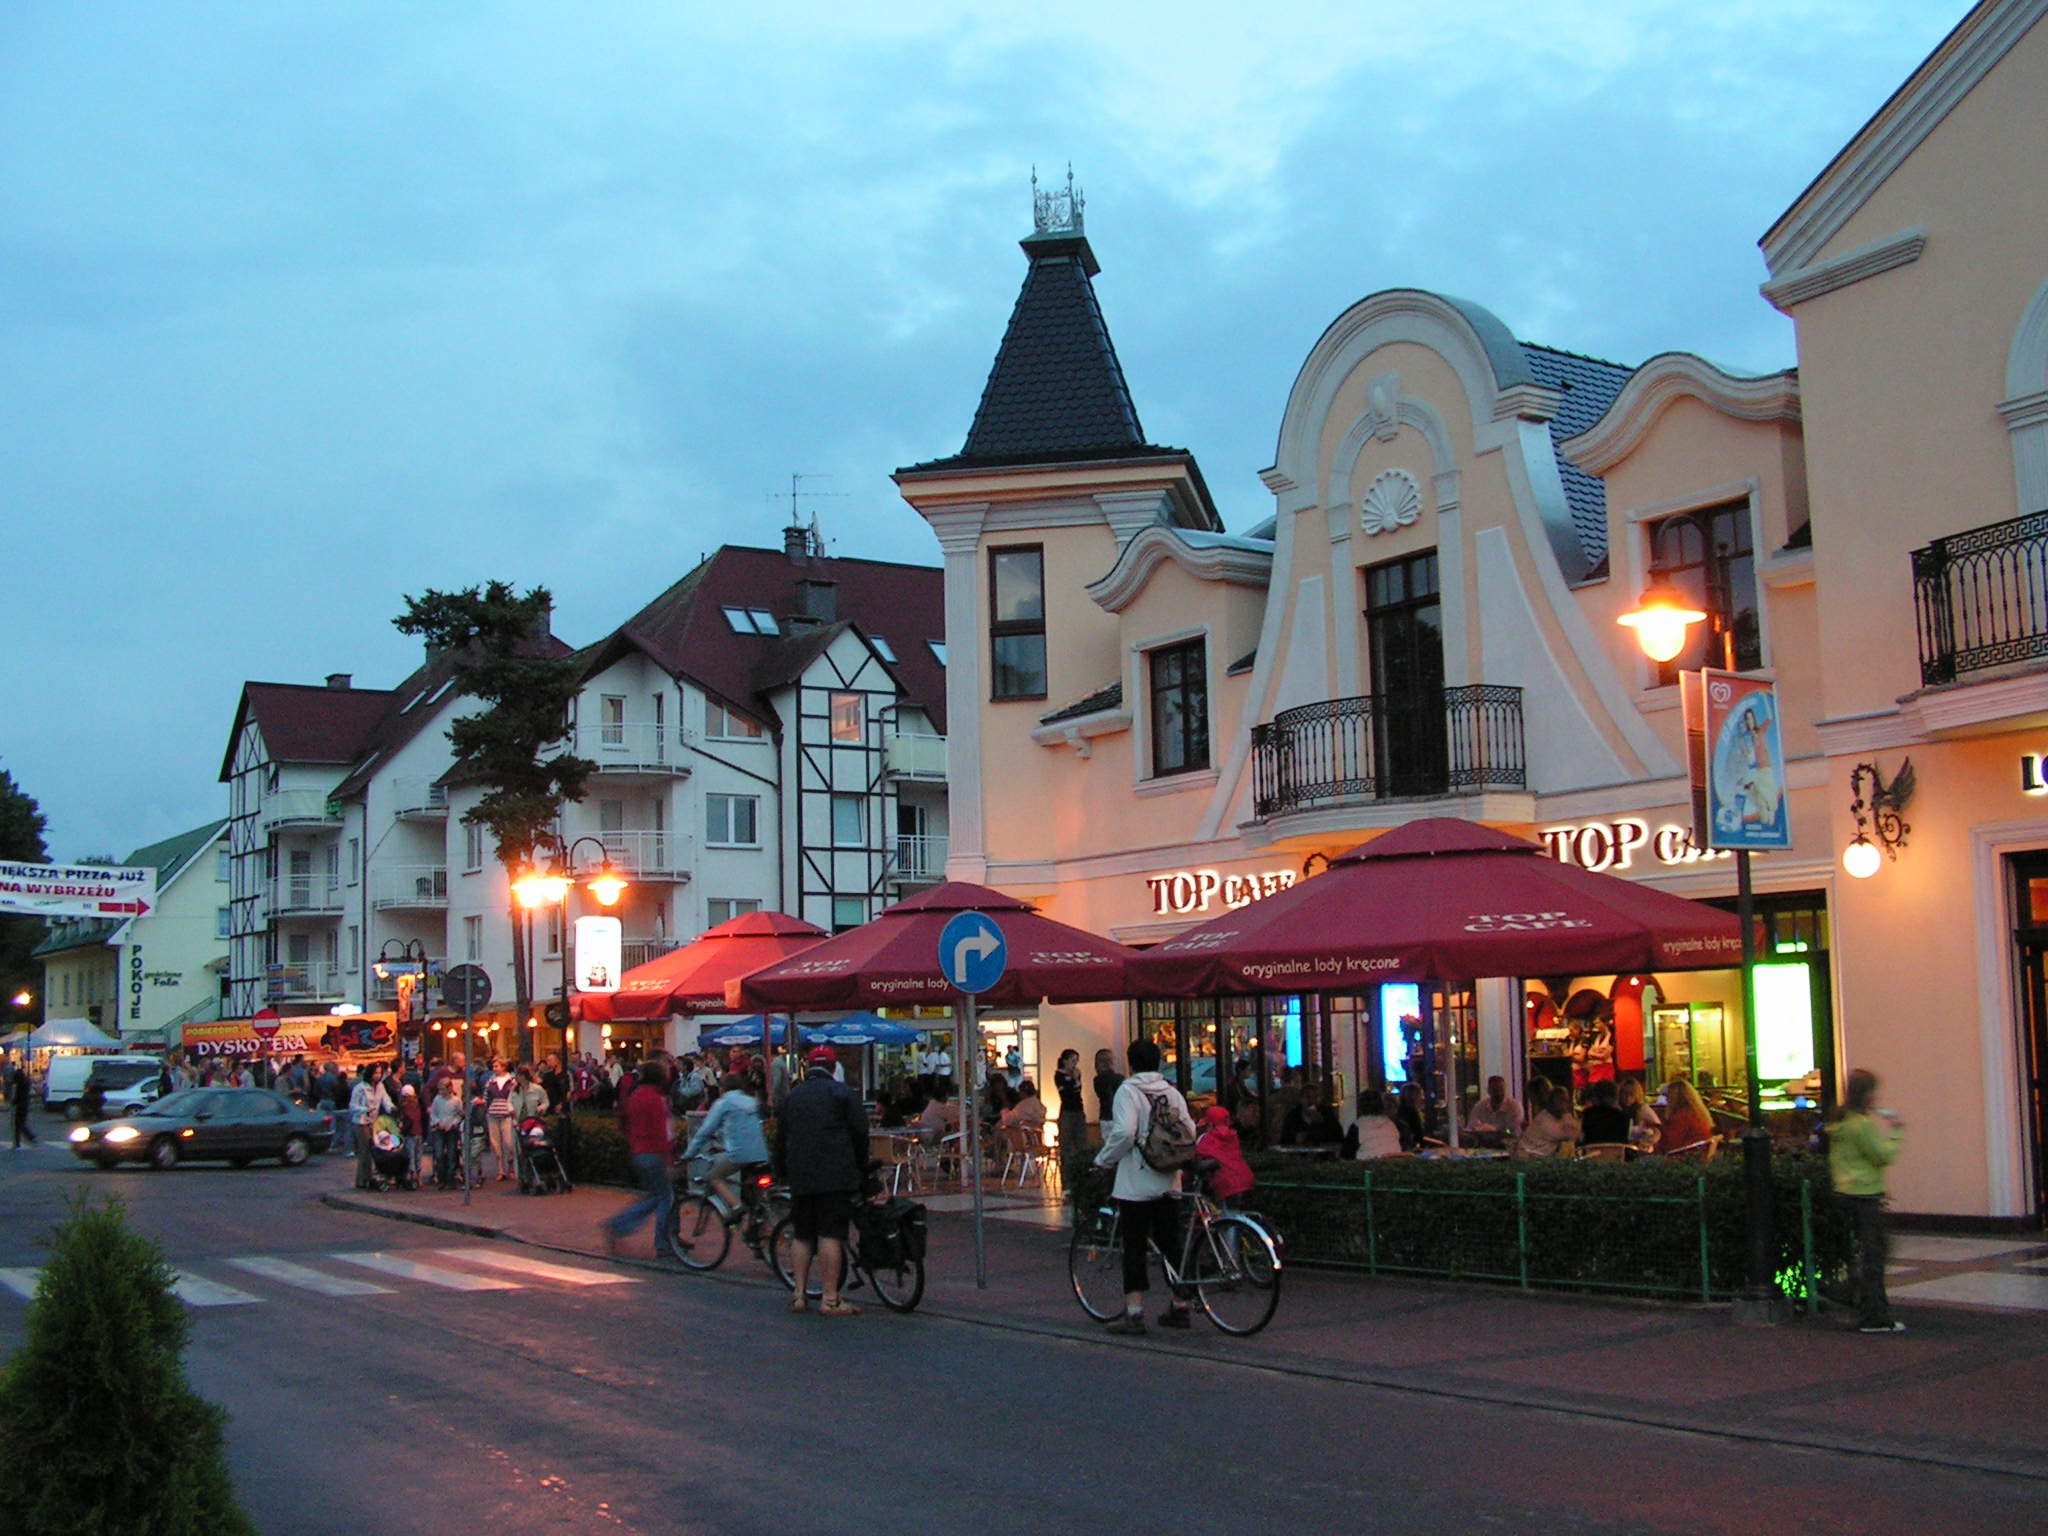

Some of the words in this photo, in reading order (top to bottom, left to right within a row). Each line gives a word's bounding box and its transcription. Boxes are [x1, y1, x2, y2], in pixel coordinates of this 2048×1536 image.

[1538, 820, 1647, 871] TOP
[0, 865, 58, 880] IĘKSZA
[65, 869, 112, 880] PIZZA
[118, 870, 145, 882] JUŻ
[0, 881, 22, 893] NA
[26, 884, 116, 897] WYBRZEŻU
[1147, 871, 1220, 914] TOP
[1467, 911, 1568, 922] TOP
[1463, 919, 1593, 932] CAFE
[1704, 936, 1721, 952] lody
[1242, 958, 1312, 979] oryginalne
[1314, 957, 1343, 975] lody
[1346, 956, 1400, 972] kręcone
[131, 944, 143, 1019] POKOJE
[870, 978, 924, 992] oryginalne
[927, 977, 950, 991] lody
[686, 998, 726, 1009] oryginaln
